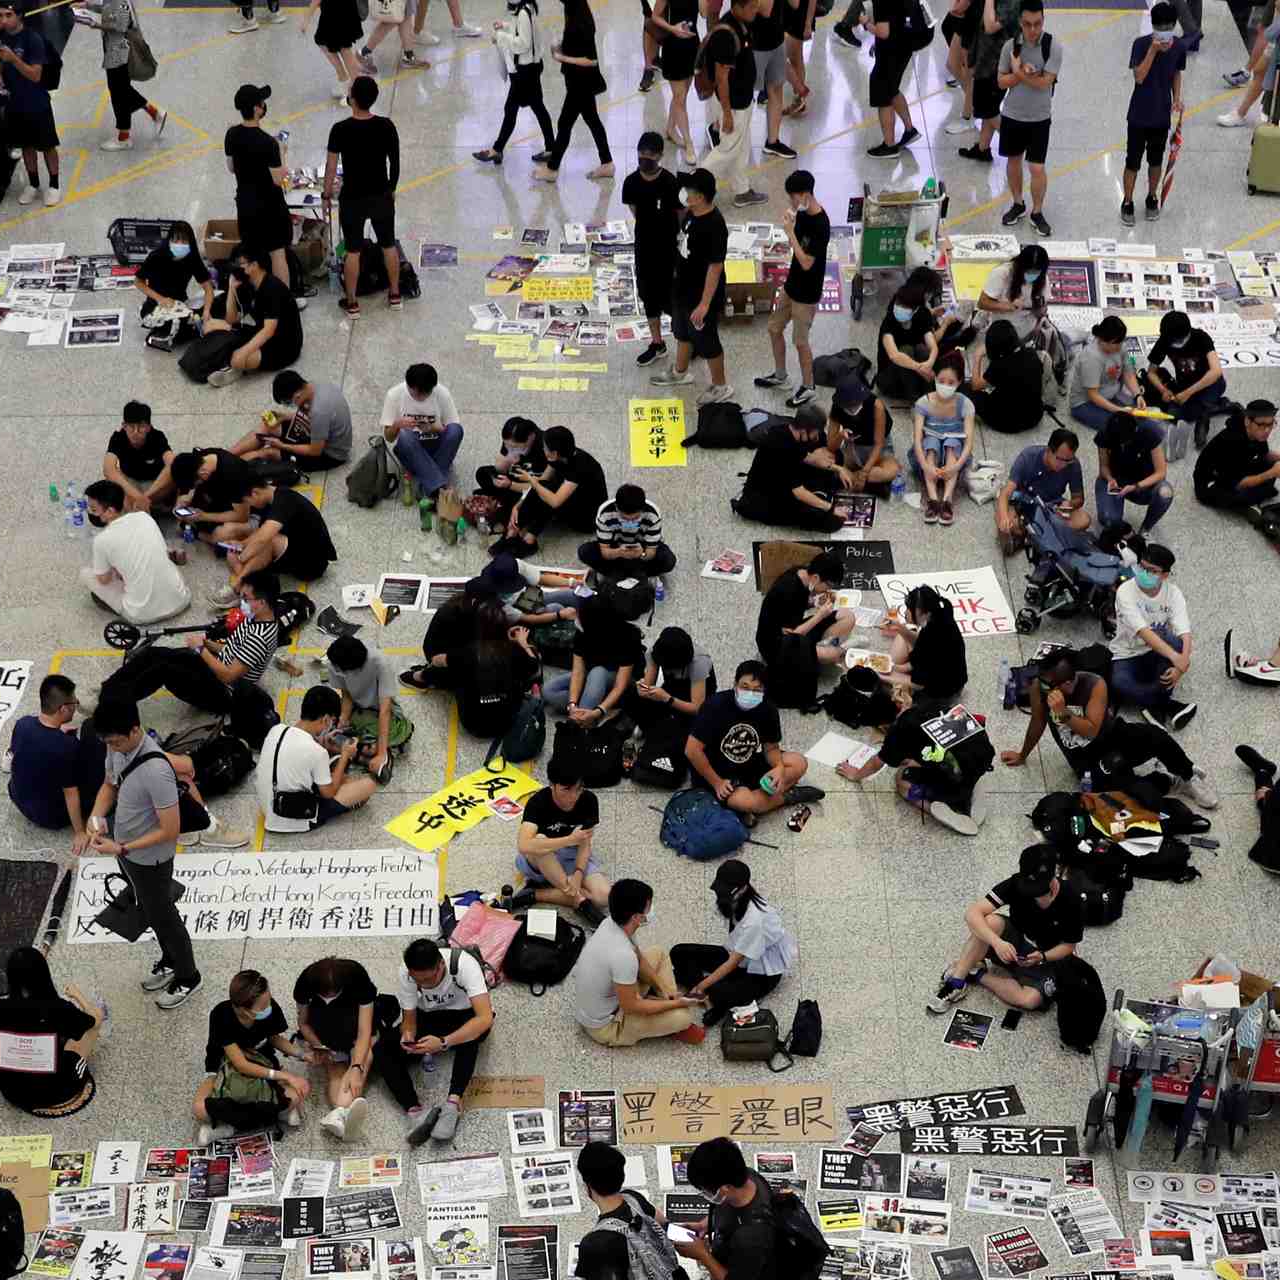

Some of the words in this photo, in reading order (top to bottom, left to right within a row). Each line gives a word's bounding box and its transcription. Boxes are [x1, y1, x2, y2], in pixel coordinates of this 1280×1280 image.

[887, 579, 974, 600] SME
[960, 616, 1011, 634] ICE
[413, 776, 518, 835] 反送中
[72, 903, 434, 938] 反條例捍衛香港自由
[1173, 1084, 1211, 1097] QIA
[622, 1090, 833, 1137] 黑警還眼
[862, 1089, 1012, 1131] 黑警惡行
[911, 1126, 1069, 1155] 黑警惡行
[825, 1153, 854, 1164] THEY
